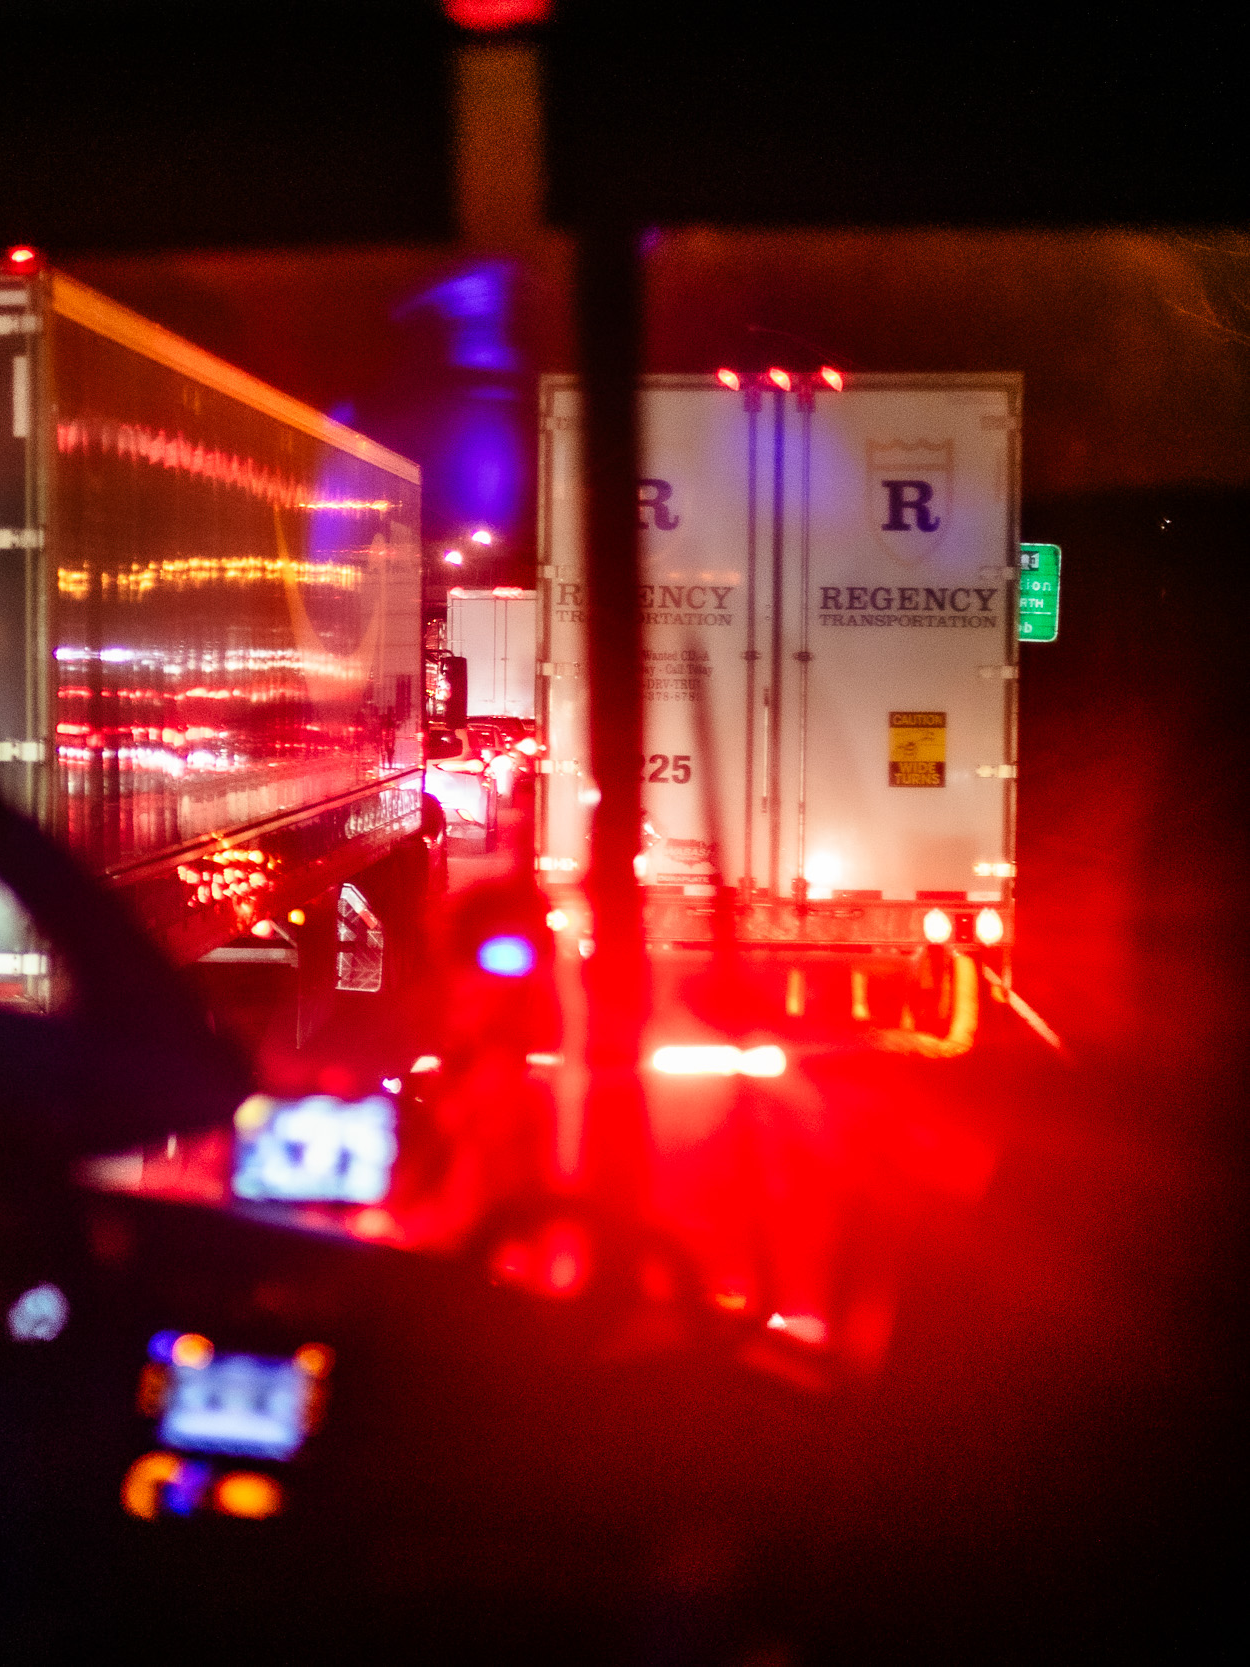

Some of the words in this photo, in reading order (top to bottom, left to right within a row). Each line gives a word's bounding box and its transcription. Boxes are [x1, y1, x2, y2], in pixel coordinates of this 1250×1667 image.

[637, 478, 681, 531] R
[881, 480, 941, 532] R
[556, 583, 734, 610] RENCY
[819, 586, 998, 612] REGENCY
[819, 614, 998, 628] TRANSPORTATION
[892, 714, 943, 725] CAUTION
[642, 754, 692, 784] 25
[894, 773, 941, 785] TURNS
[899, 762, 937, 773] WIDE
